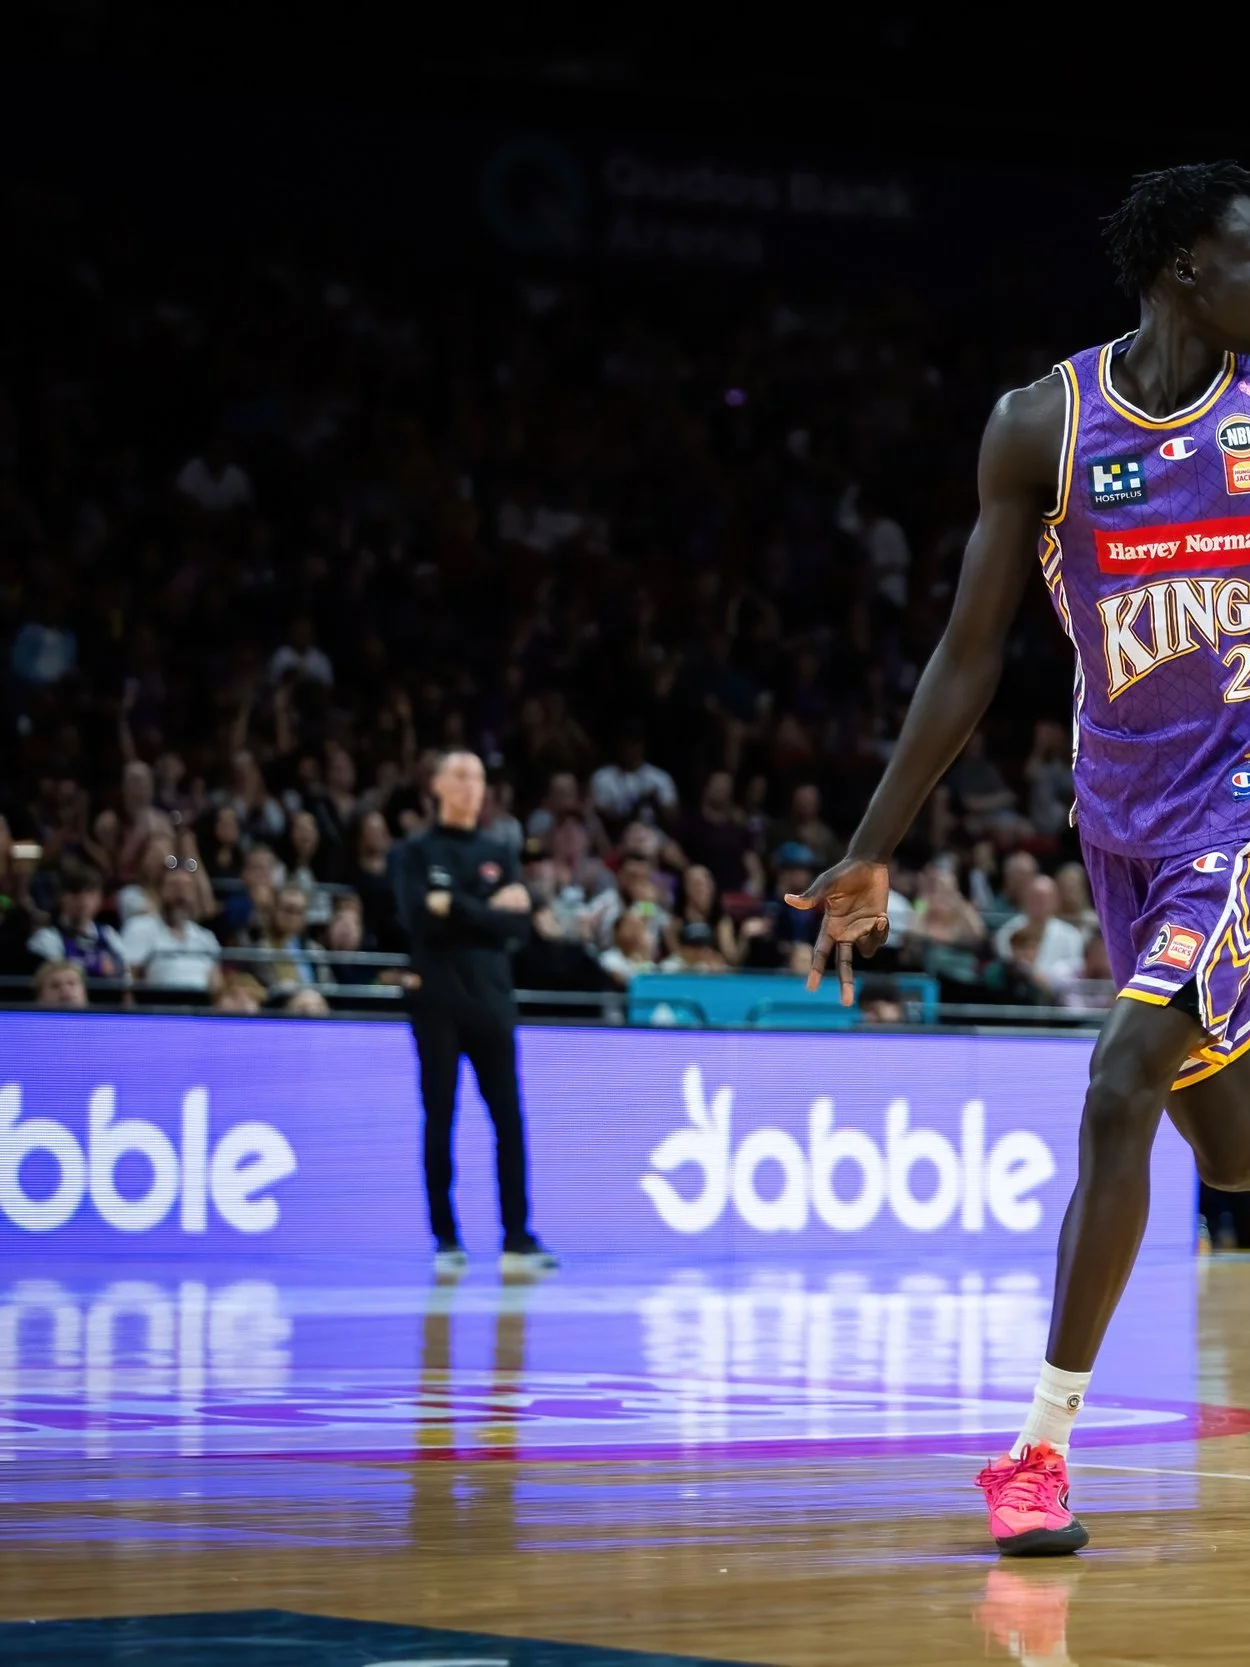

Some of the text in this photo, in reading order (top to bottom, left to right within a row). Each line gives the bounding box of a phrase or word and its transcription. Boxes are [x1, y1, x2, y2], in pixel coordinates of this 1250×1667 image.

[1095, 490, 1142, 503] HOSTPLUS
[1107, 540, 1181, 560] Harvey
[640, 1062, 1056, 1233] dabble
